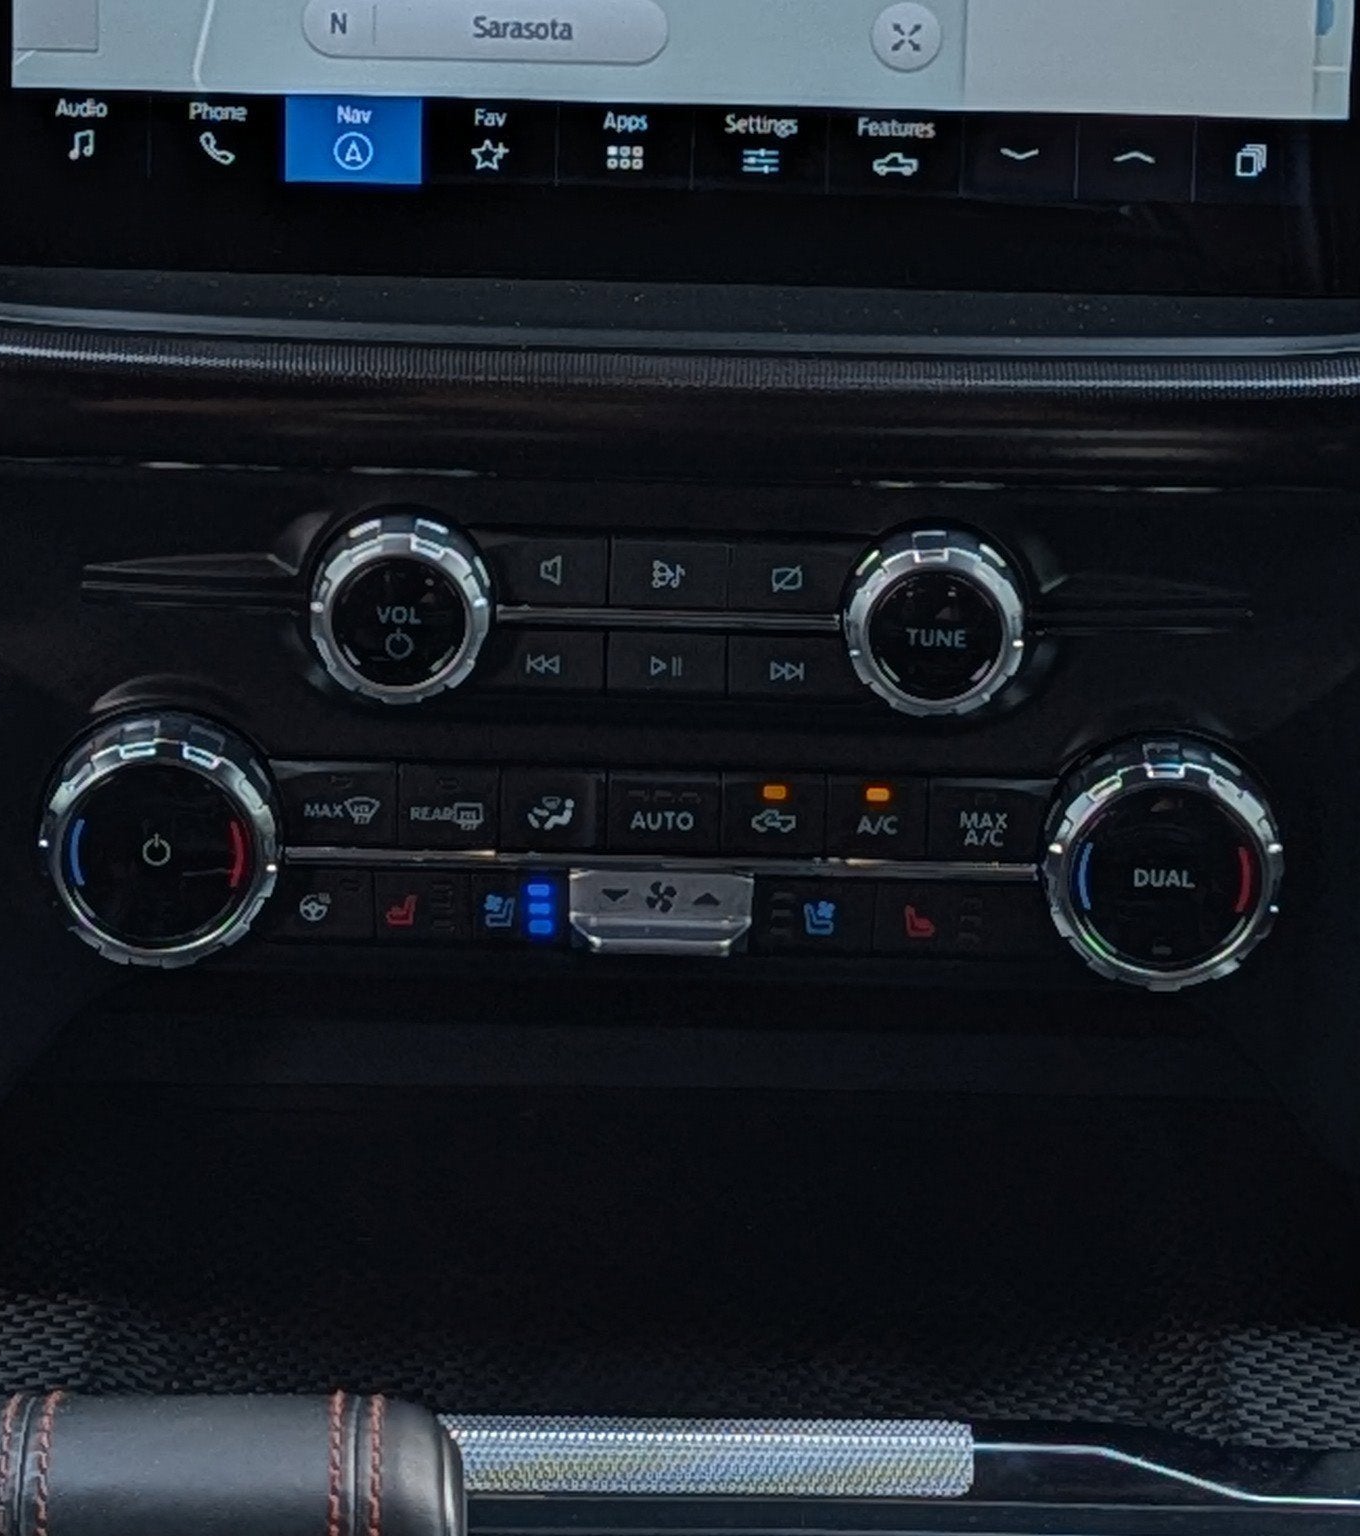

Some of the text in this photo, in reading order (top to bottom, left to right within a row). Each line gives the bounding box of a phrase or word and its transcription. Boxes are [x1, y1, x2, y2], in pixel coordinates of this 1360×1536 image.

[329, 13, 348, 35] N
[471, 16, 574, 42] Sarasota
[55, 97, 108, 118] Audio
[189, 102, 248, 123] Phone
[337, 106, 372, 125] Nav
[473, 108, 507, 128] Fav
[603, 111, 649, 134] Apps
[724, 113, 798, 138] Settings
[857, 116, 936, 139] Features
[375, 605, 421, 625] VOL
[906, 628, 967, 651] TUNE
[303, 802, 345, 818] MAX
[410, 806, 455, 821] REAR
[630, 811, 695, 832] AUTO
[856, 814, 899, 836] A/C
[959, 811, 1009, 831] MAX
[963, 828, 1005, 848] A/C
[1133, 868, 1195, 890] DUAL
